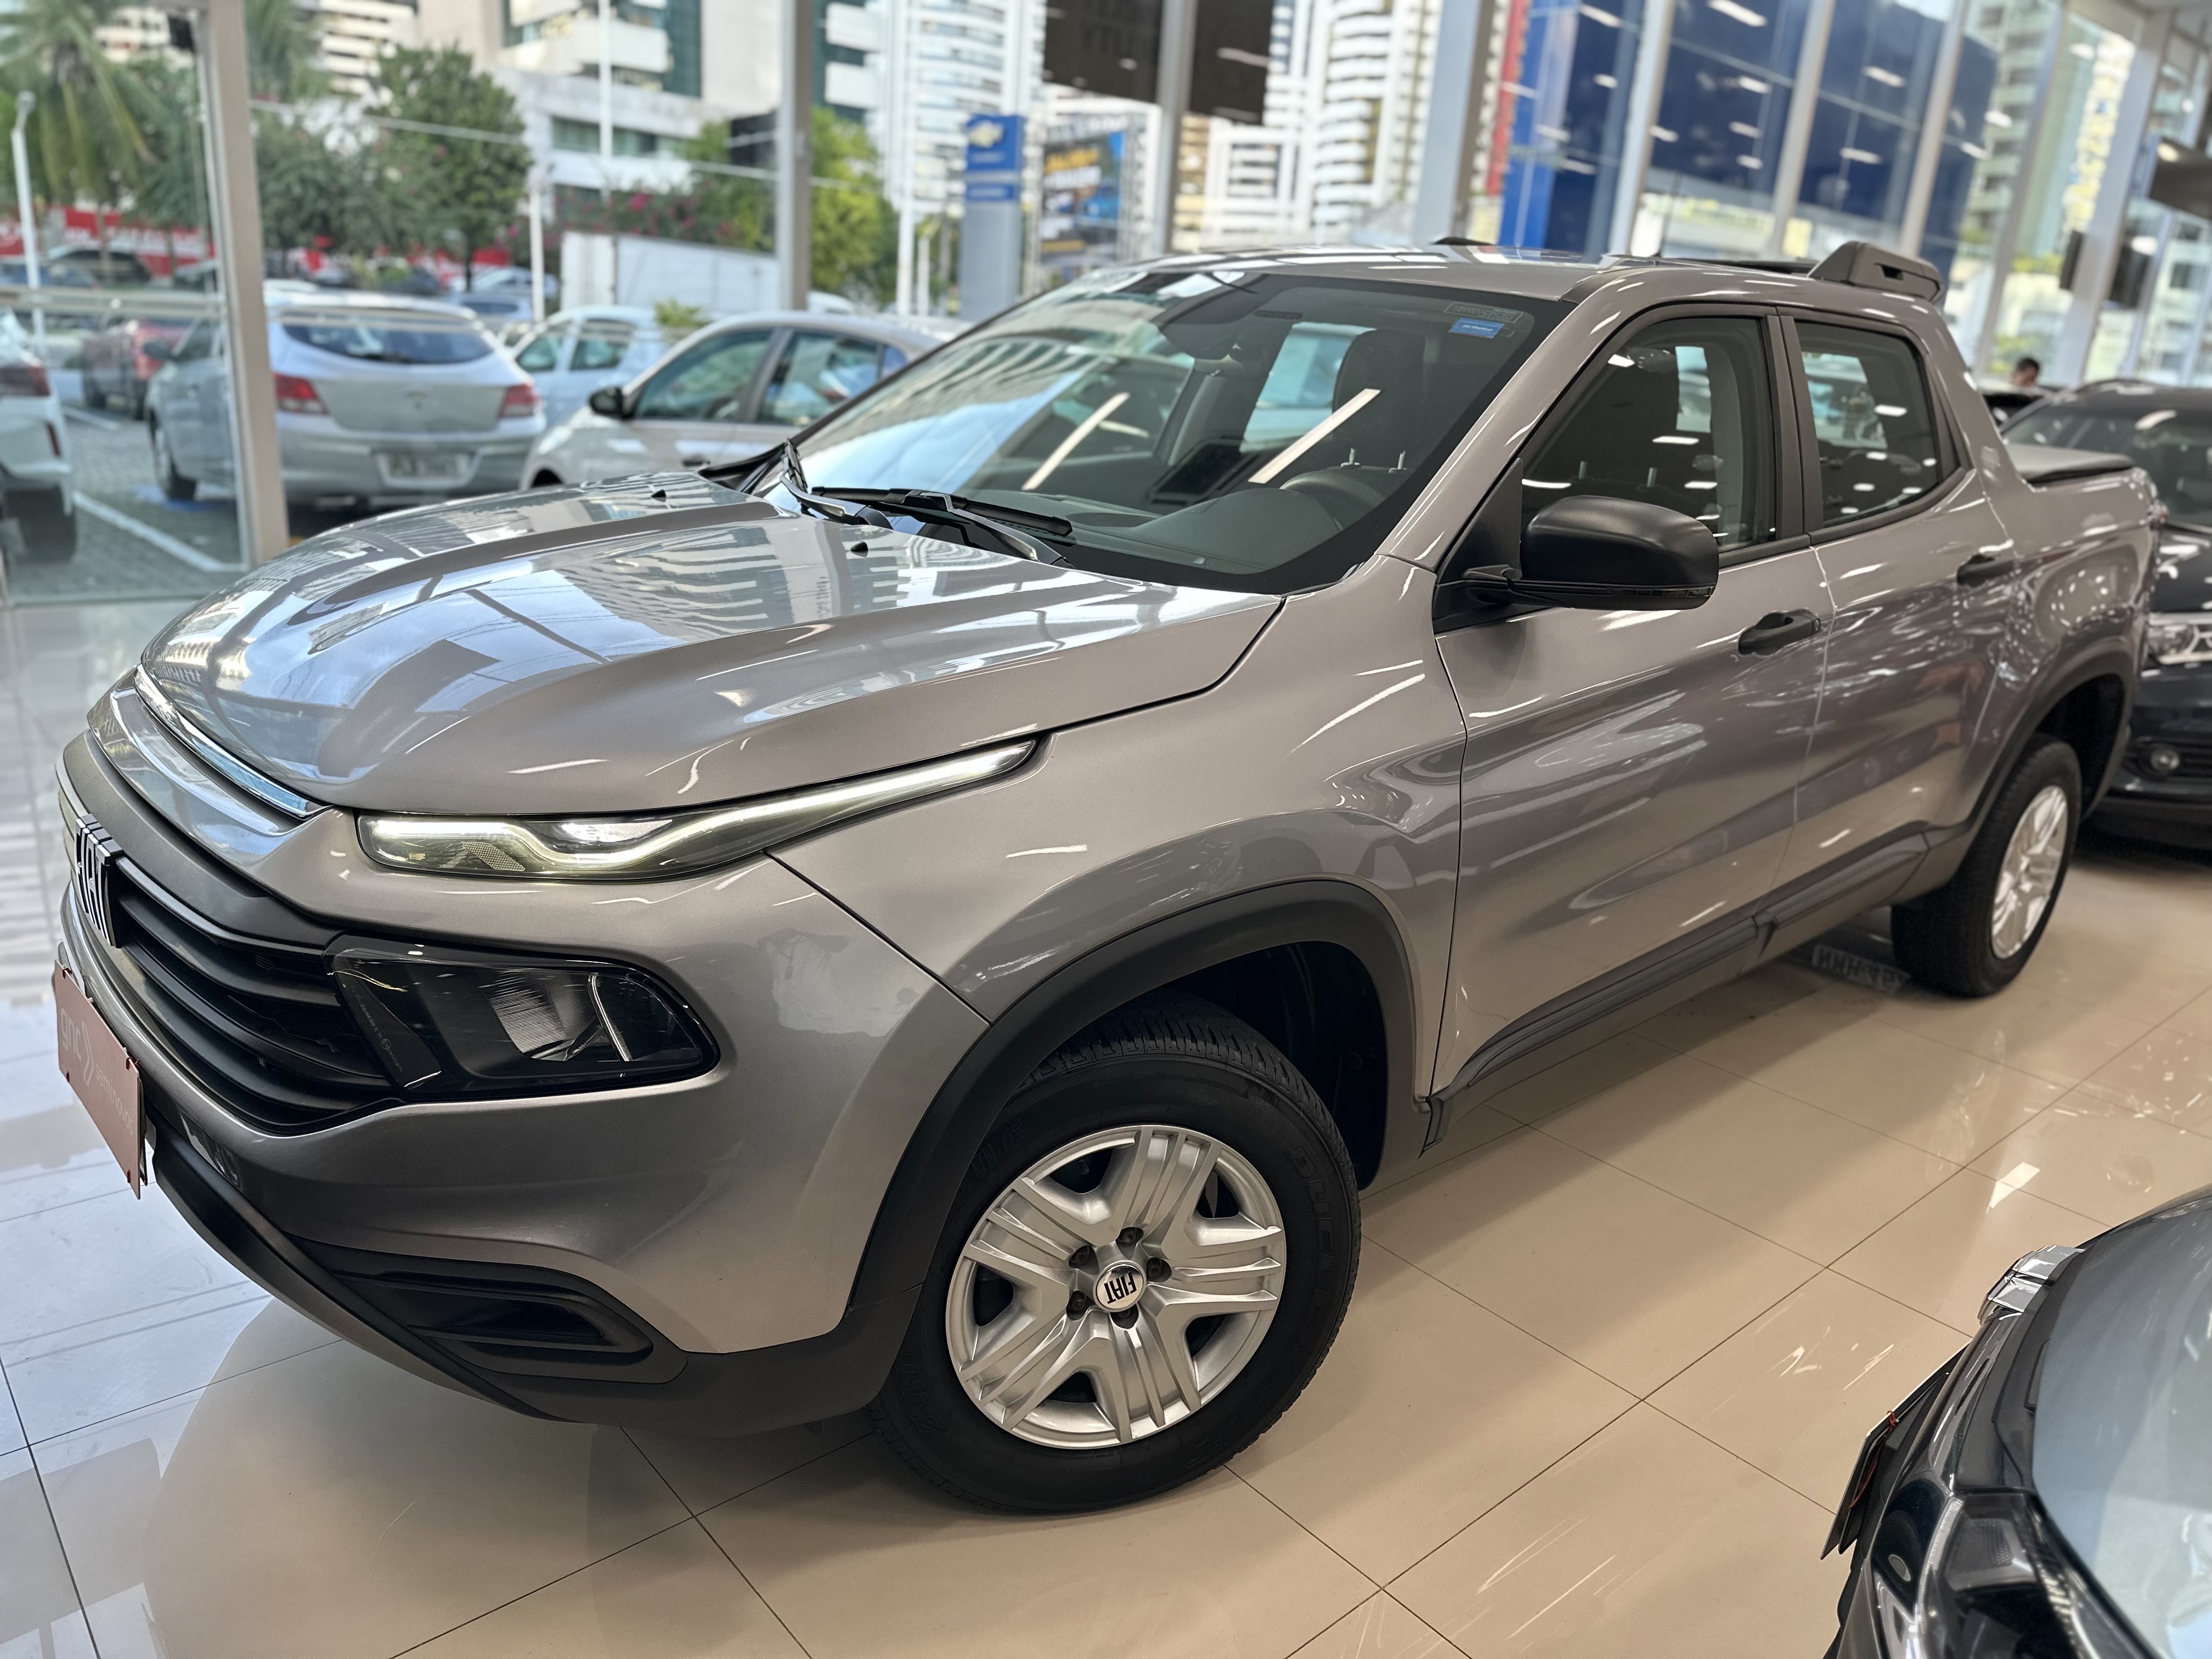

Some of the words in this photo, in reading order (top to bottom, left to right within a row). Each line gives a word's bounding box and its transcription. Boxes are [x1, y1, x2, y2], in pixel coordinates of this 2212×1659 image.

[75, 816, 118, 947] FIAT
[60, 1007, 82, 1060] gnc
[94, 1063, 134, 1137] seminovos
[1103, 1271, 1137, 1305] FIAT
